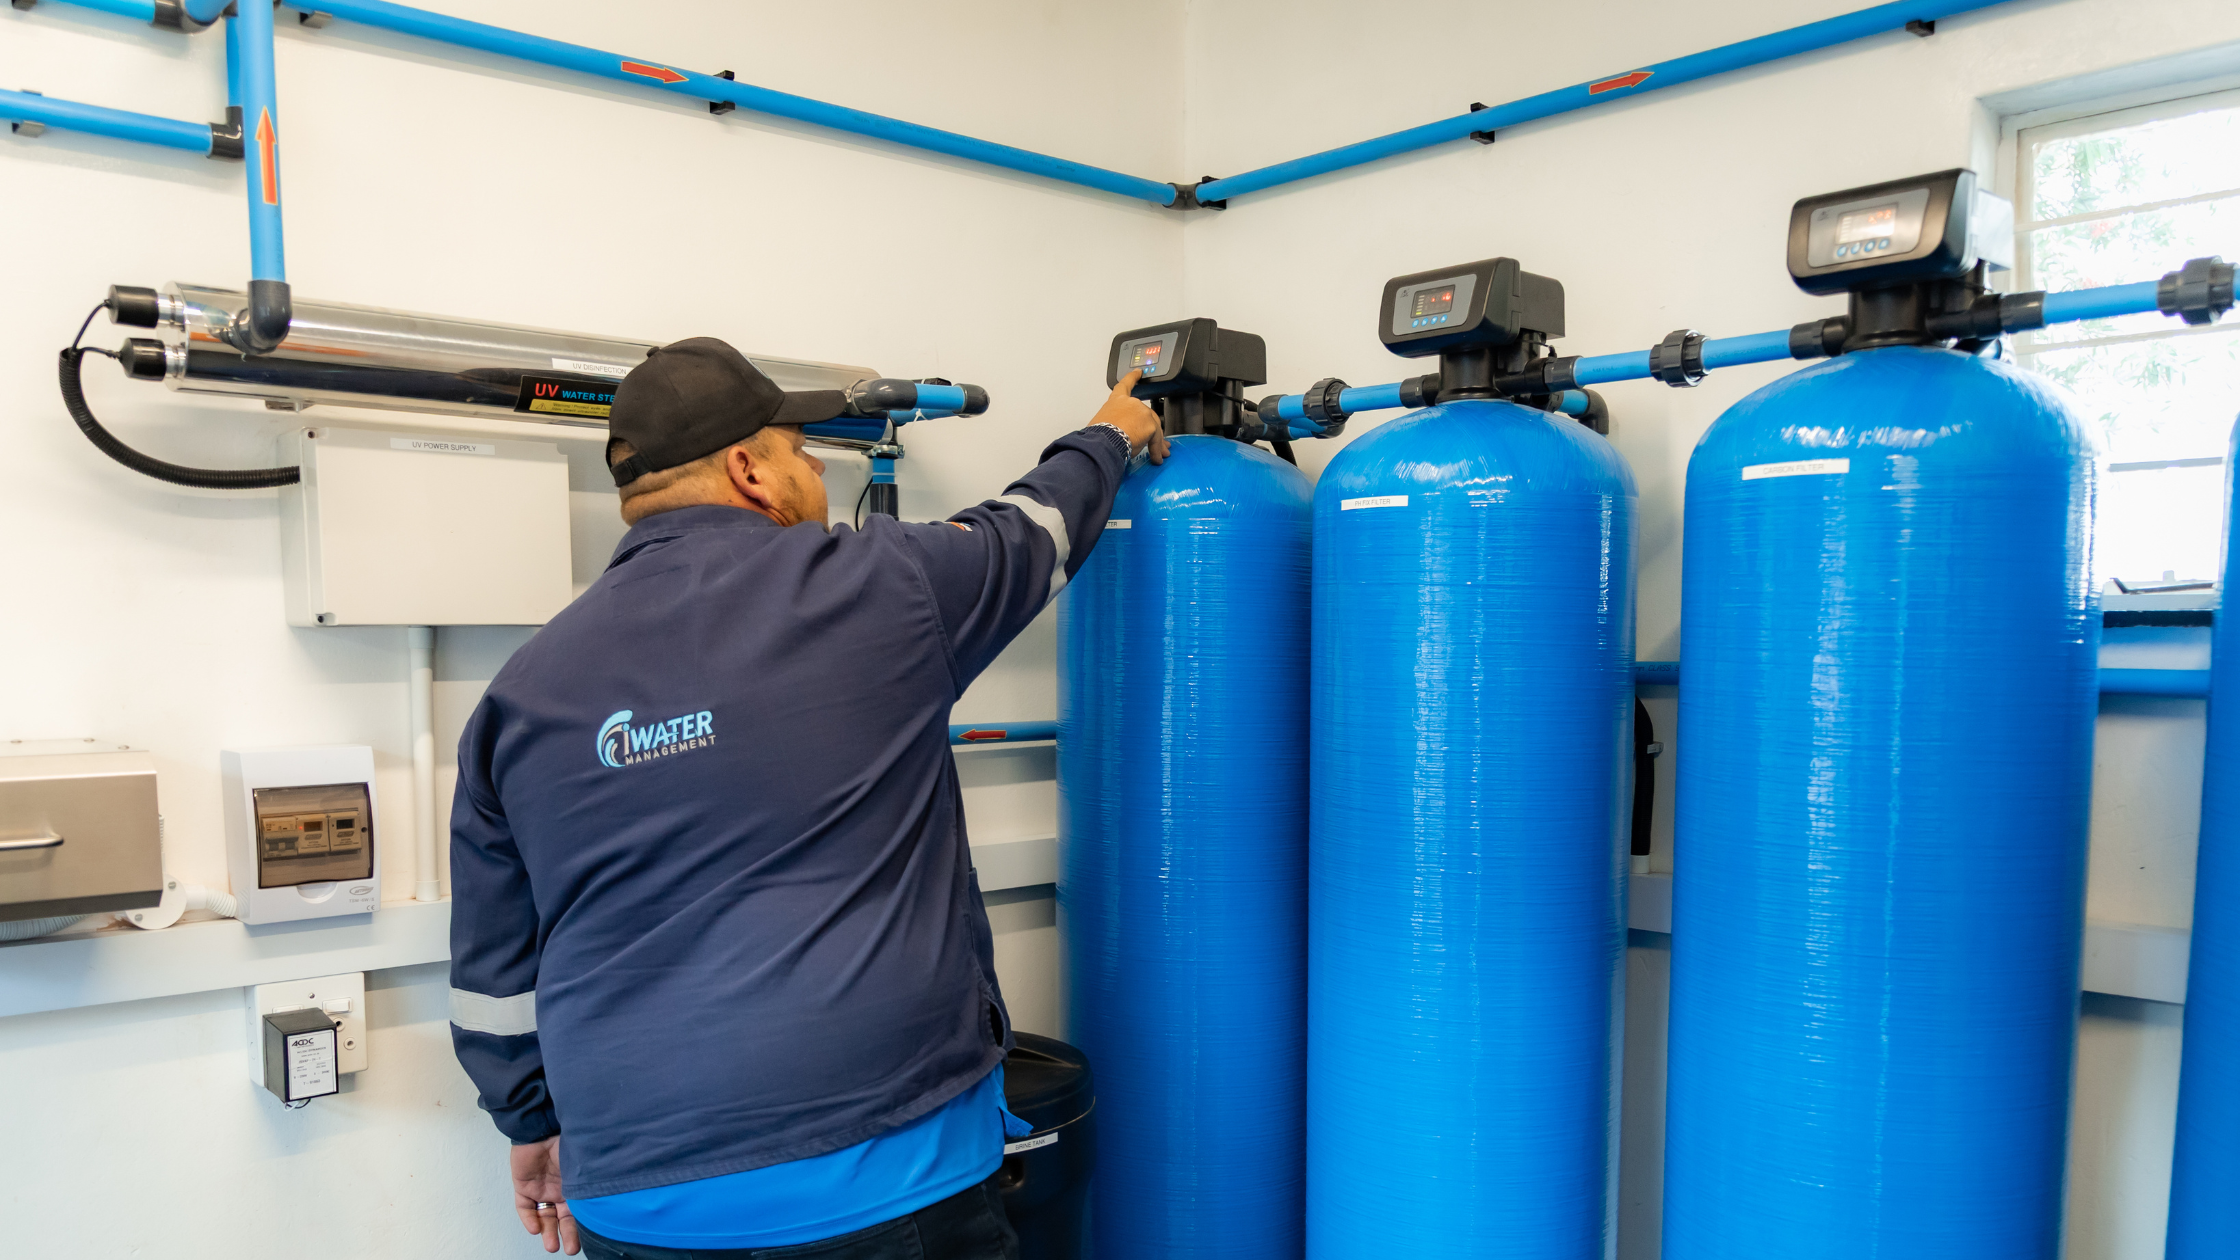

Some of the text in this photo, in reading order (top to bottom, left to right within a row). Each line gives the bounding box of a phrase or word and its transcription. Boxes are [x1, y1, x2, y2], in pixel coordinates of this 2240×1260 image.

[583, 364, 627, 375] DISINFECTION
[535, 383, 615, 402] UV WATER STE
[1762, 464, 1824, 474] CARBON FILTER
[624, 735, 716, 766] MANAGEMENT
[1015, 1142, 1032, 1150] BRINE
